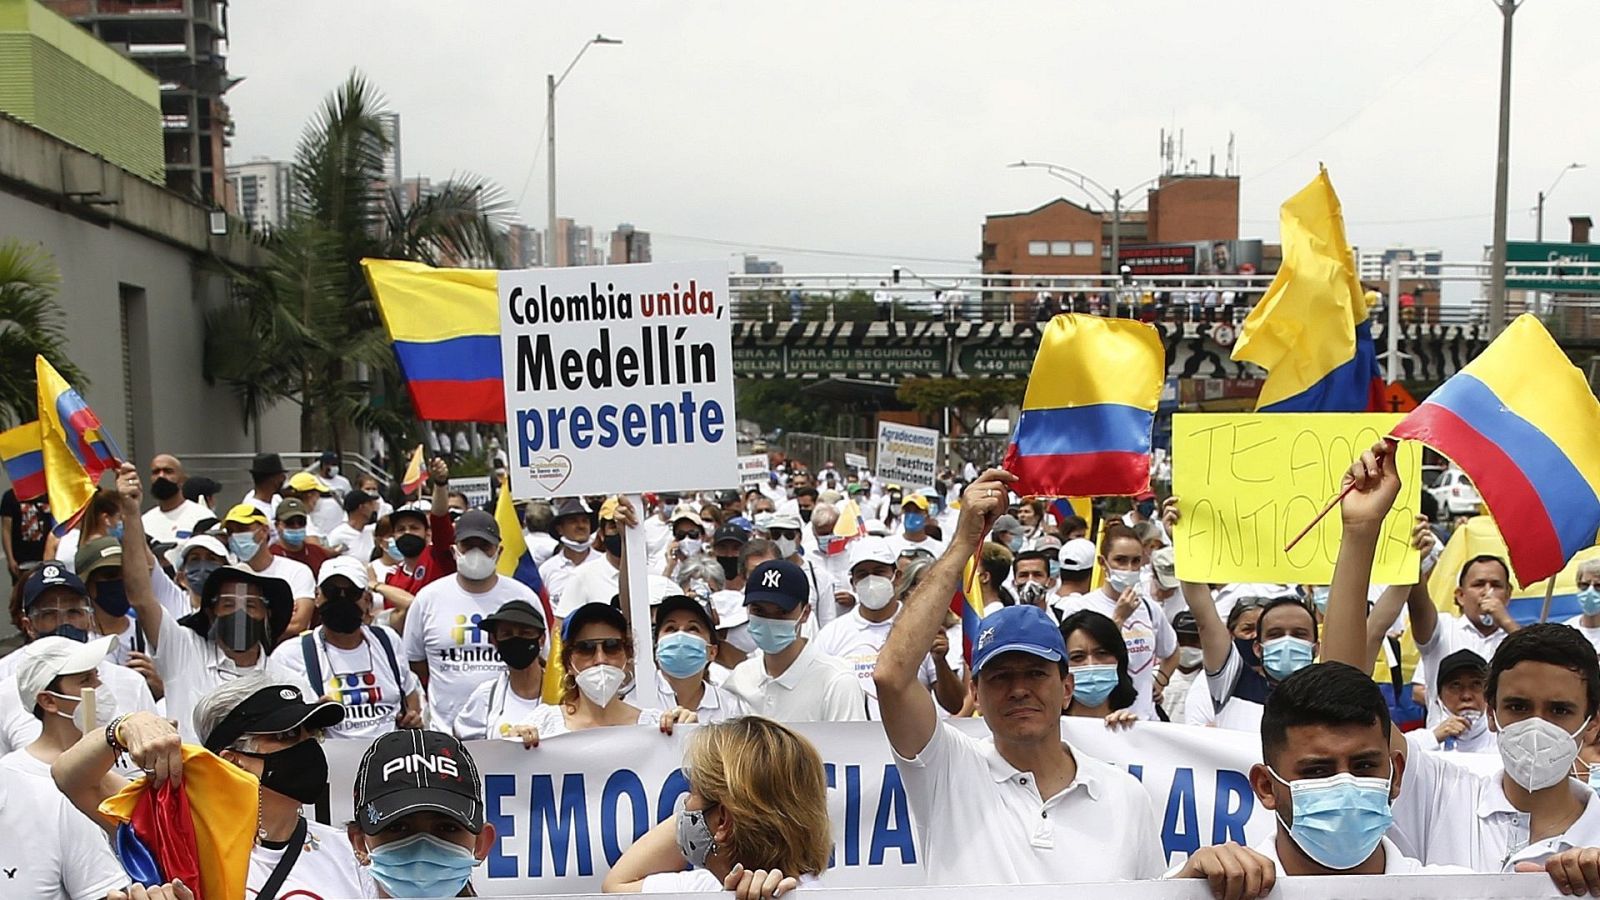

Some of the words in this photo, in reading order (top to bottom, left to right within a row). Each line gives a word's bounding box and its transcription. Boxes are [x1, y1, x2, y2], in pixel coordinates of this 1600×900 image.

[508, 282, 633, 325] Colombia
[640, 280, 723, 320] unida,
[516, 325, 716, 391] Medellín
[768, 349, 778, 358] A
[790, 348, 826, 358] PARA
[832, 348, 850, 358] SU
[854, 348, 933, 358] SEGURIDAD
[974, 348, 1027, 358] ALTURA
[734, 360, 781, 370] DELLIN
[790, 360, 842, 370] UTILICE
[847, 360, 882, 370] ESTE
[886, 360, 941, 370] PUENTE
[973, 360, 1004, 370] 4.40
[516, 391, 725, 467] presente
[880, 427, 935, 447] Agradecemos
[1189, 421, 1277, 485] TE
[879, 464, 933, 487] instituciones
[1188, 493, 1414, 577] ANTIOIA
[440, 646, 504, 662] +Unido
[345, 704, 394, 719] nidos
[382, 754, 459, 782] PING
